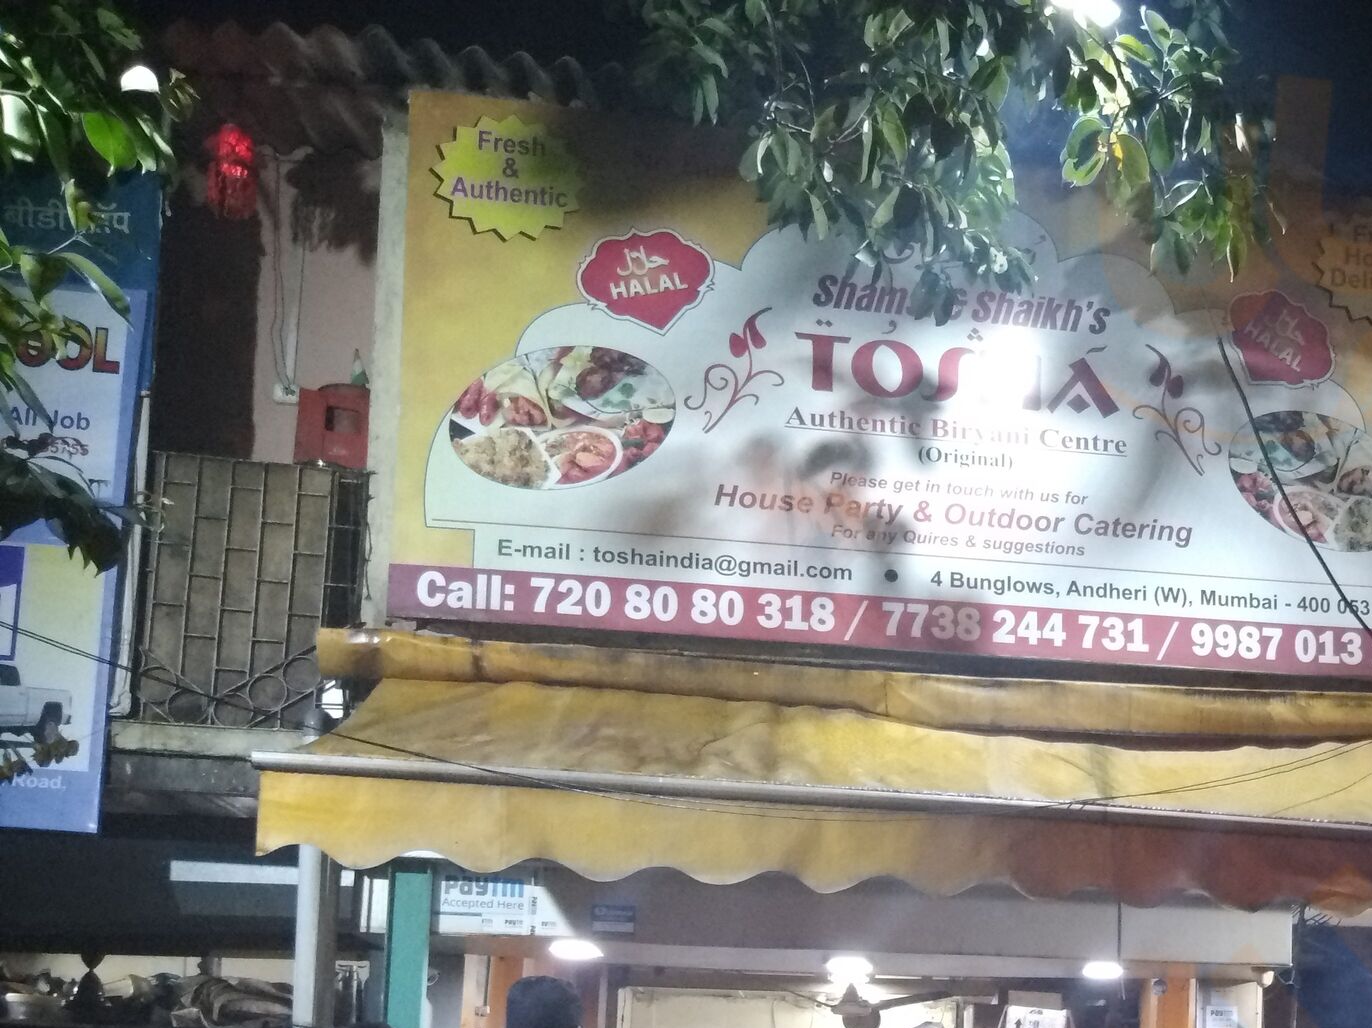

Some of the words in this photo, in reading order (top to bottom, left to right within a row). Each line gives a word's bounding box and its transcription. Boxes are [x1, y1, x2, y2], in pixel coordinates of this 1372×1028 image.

[478, 130, 545, 156] Fresh
[502, 157, 519, 179] &
[451, 176, 568, 208] Authentic
[609, 272, 688, 300] HALAL
[971, 291, 1111, 335] Shaikh's
[1243, 320, 1302, 373] HALAL
[785, 405, 921, 437] Authentic
[932, 419, 1030, 448] Biryani
[1039, 428, 1127, 454] Centre
[917, 446, 1014, 470] (Original)
[830, 471, 887, 489] Please
[893, 478, 920, 493] get
[926, 479, 940, 492] in
[947, 482, 994, 497] touch
[1000, 487, 1034, 501] with
[1040, 492, 1059, 503] us
[1065, 491, 1088, 505] for
[714, 484, 813, 513] House
[824, 493, 903, 525] Party
[913, 500, 932, 523] &
[944, 503, 1065, 533] Outdoor
[1074, 513, 1193, 548] Catering
[831, 525, 861, 540] For
[866, 530, 897, 544] any
[904, 530, 958, 547] Quires
[965, 535, 977, 548] &
[983, 537, 1085, 556] suggestions
[497, 539, 570, 560] E-mail
[593, 546, 853, 580] toshaindia@gmail.com
[931, 571, 943, 587] 4
[950, 572, 1060, 597] Bunglows,
[1067, 580, 1147, 602] Andheri
[1154, 586, 1193, 608] (W),
[1201, 590, 1278, 610] Mumbai
[1297, 597, 1331, 614] 400
[416, 571, 515, 611] Call:
[530, 577, 611, 617] 720
[624, 584, 678, 622] 80
[690, 589, 744, 626] 80
[756, 593, 835, 632] 318
[843, 600, 869, 641] /
[882, 602, 981, 642] 7738
[992, 610, 1066, 645] 244
[1077, 614, 1149, 652] 731
[1156, 621, 1179, 661] /
[1190, 623, 1283, 661] 9987
[1294, 629, 1363, 665] 013
[442, 898, 494, 909] Accepted
[497, 900, 525, 910] Here
